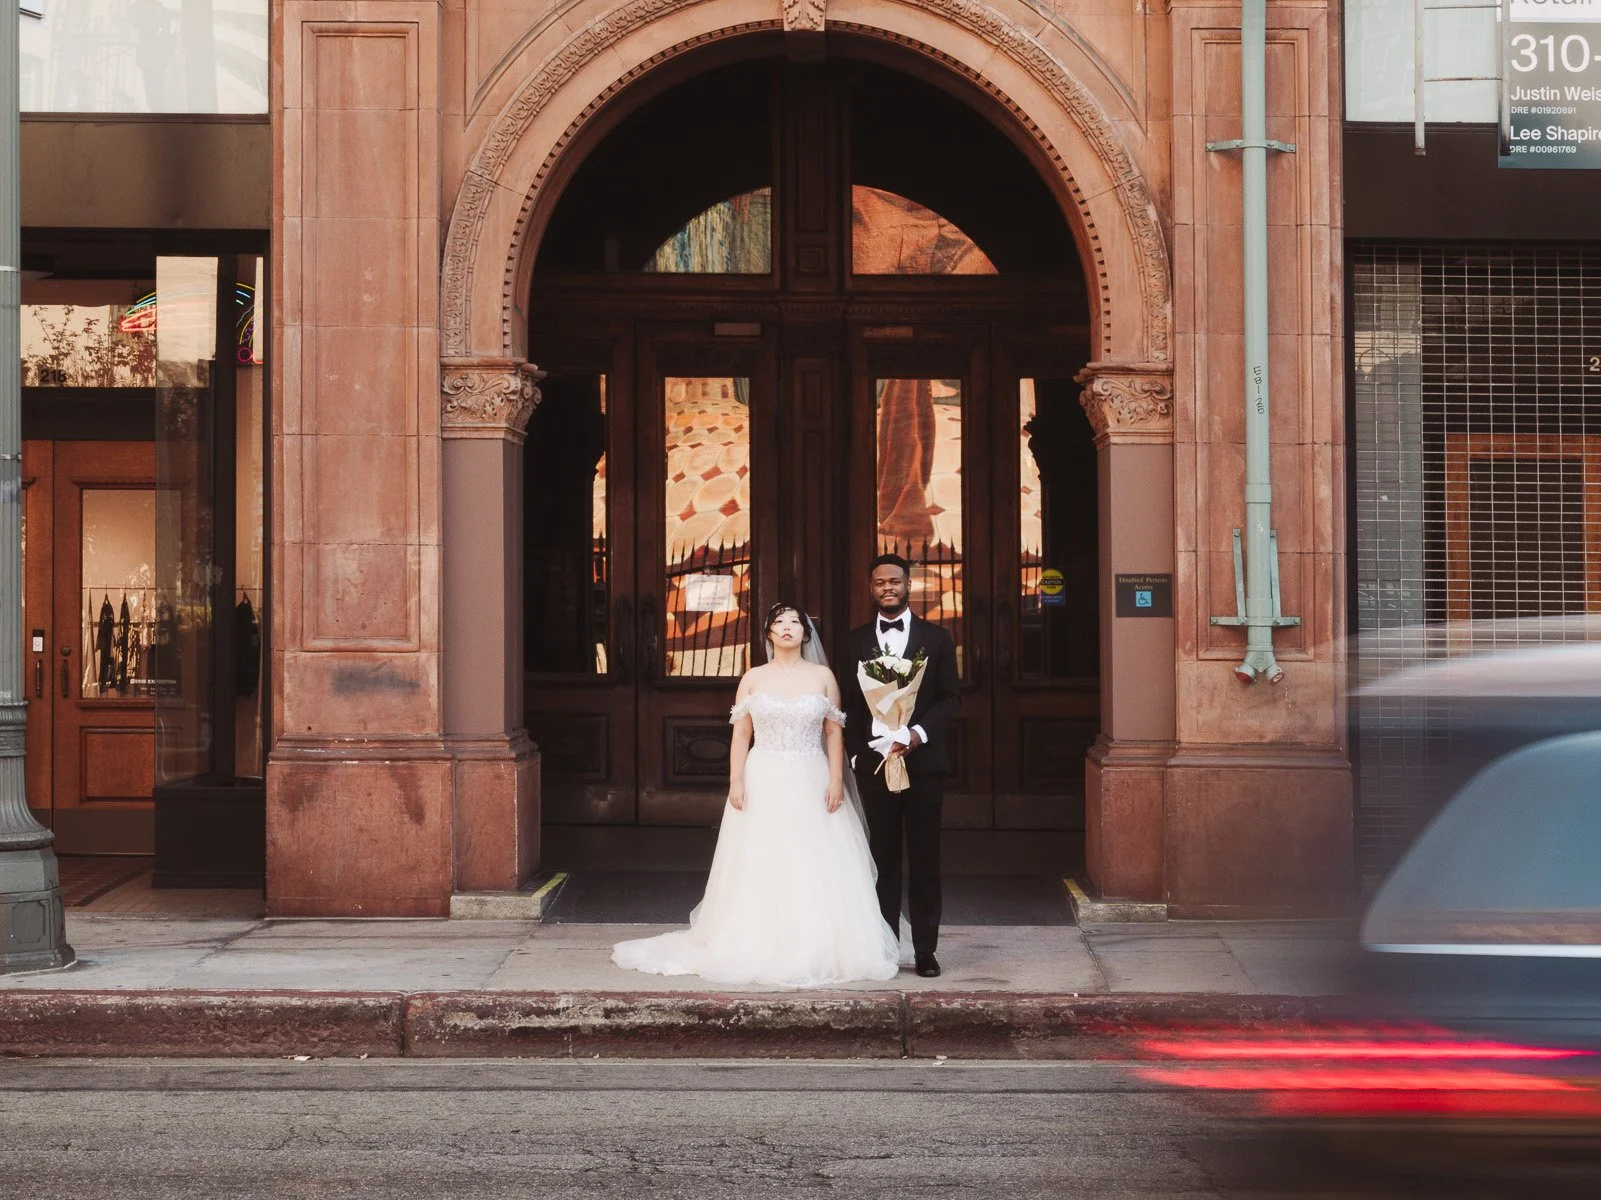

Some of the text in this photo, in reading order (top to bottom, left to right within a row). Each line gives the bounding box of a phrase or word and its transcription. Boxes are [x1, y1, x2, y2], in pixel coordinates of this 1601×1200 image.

[1511, 34, 1601, 73] 310-
[1511, 86, 1560, 101] Justin
[1511, 106, 1529, 114] DRE
[1510, 125, 1541, 140] Lee
